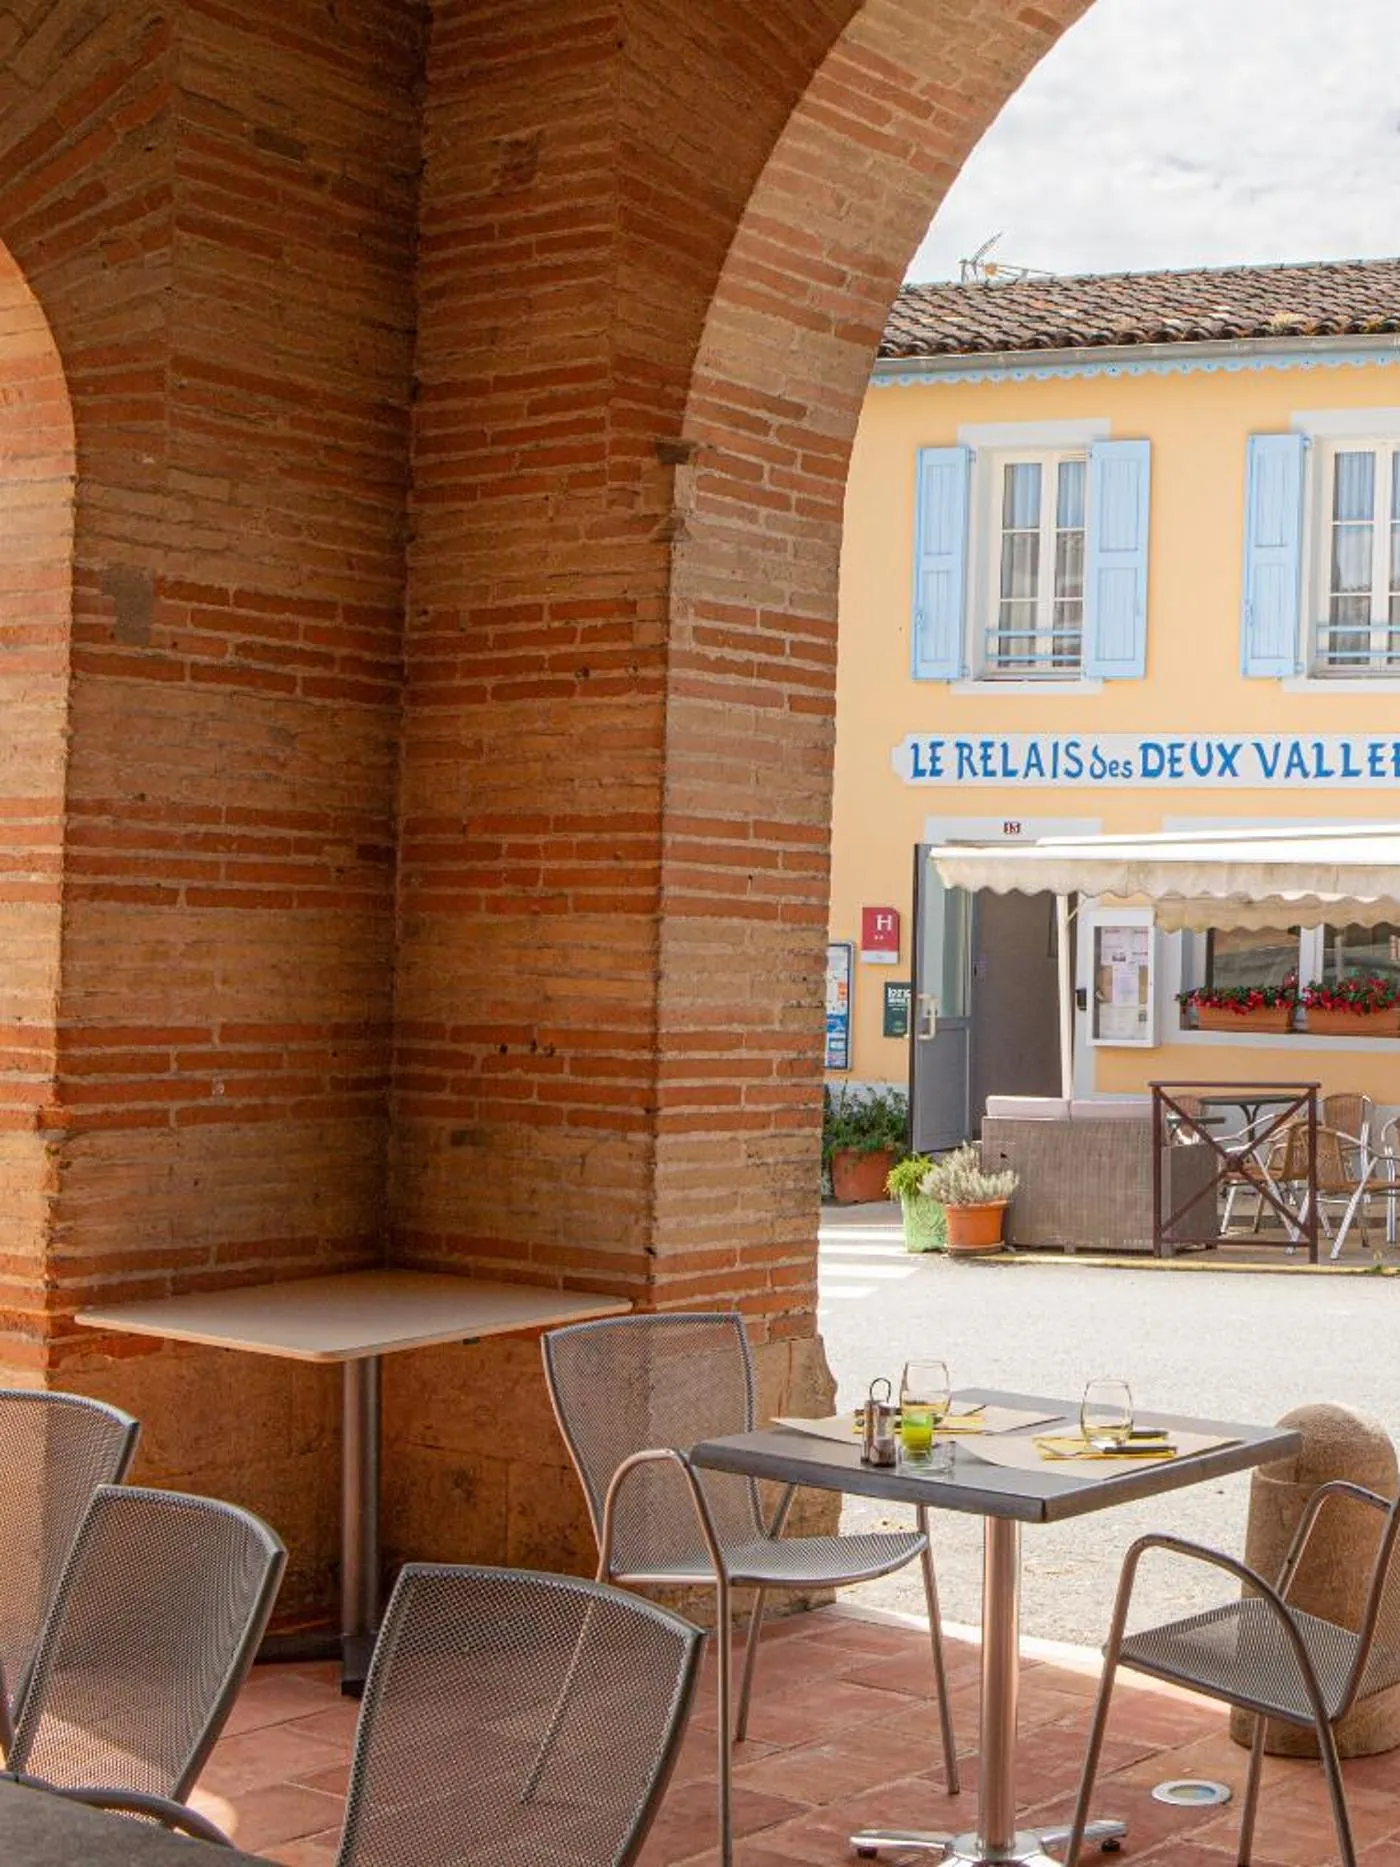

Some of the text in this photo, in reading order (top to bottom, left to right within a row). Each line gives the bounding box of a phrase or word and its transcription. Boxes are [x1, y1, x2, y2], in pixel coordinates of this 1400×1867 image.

[910, 742, 945, 778] LE
[955, 742, 1084, 780] RELAIS
[1089, 744, 1133, 780] des
[1139, 741, 1244, 779] DEUX
[876, 914, 893, 931] H
